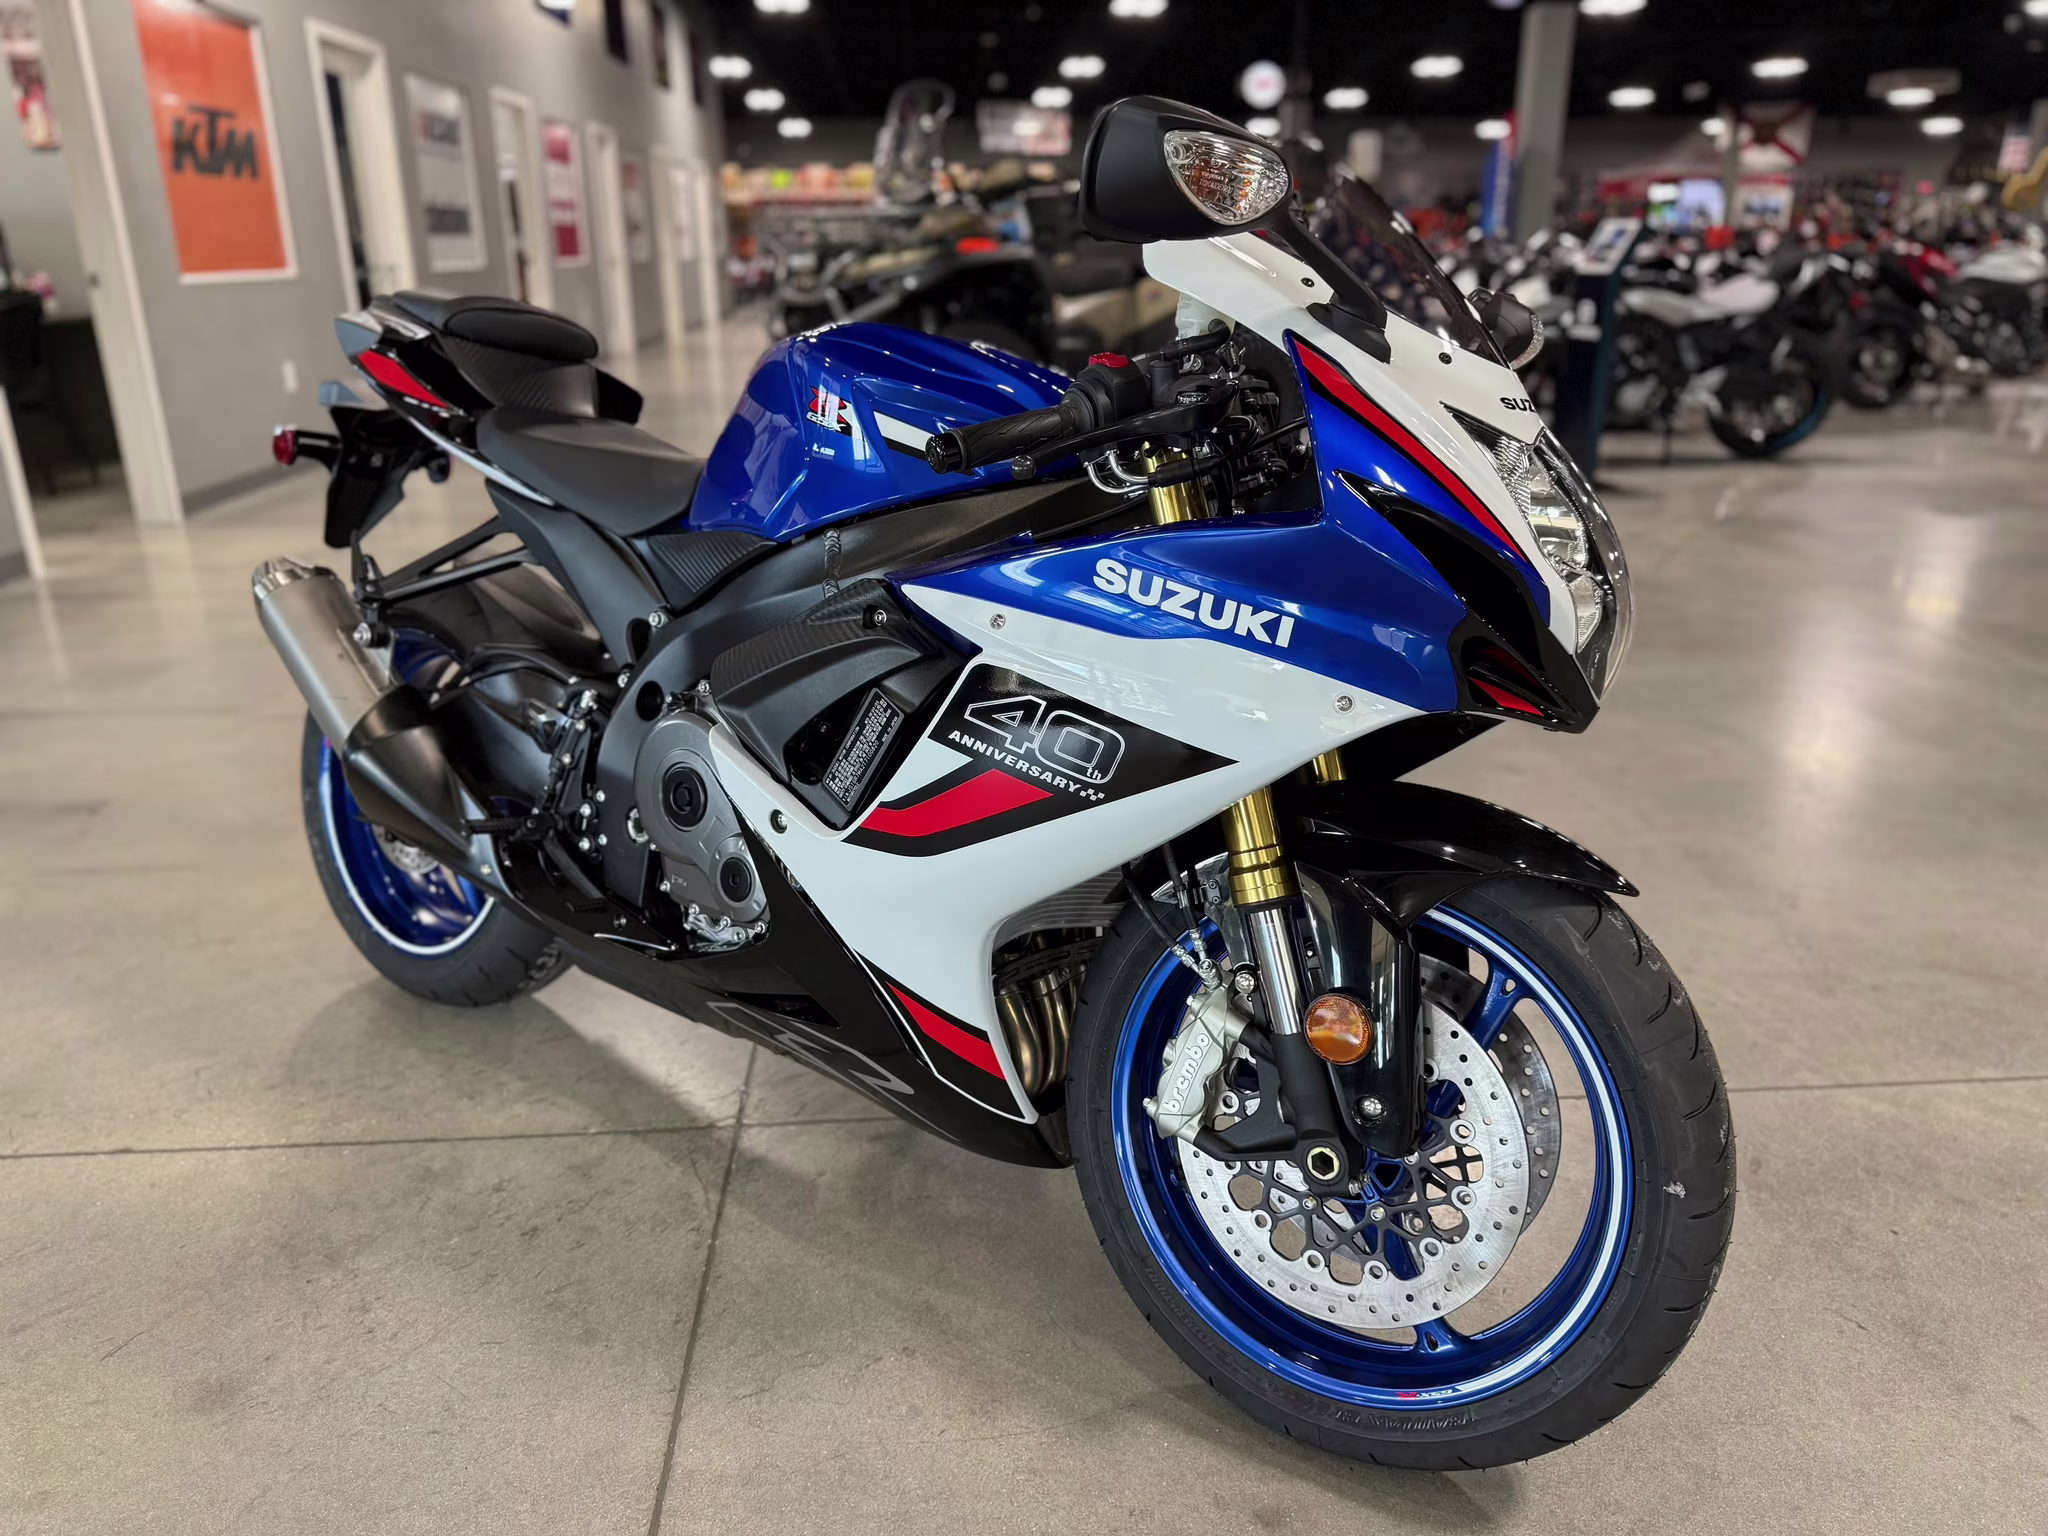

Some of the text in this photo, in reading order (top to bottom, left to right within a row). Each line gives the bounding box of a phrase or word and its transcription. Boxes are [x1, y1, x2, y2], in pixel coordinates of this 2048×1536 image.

[173, 104, 259, 180] KTM
[1093, 558, 1295, 648] SUZUKI
[948, 730, 1082, 793] ANNIVERSARY
[1162, 1033, 1210, 1113] brembo
